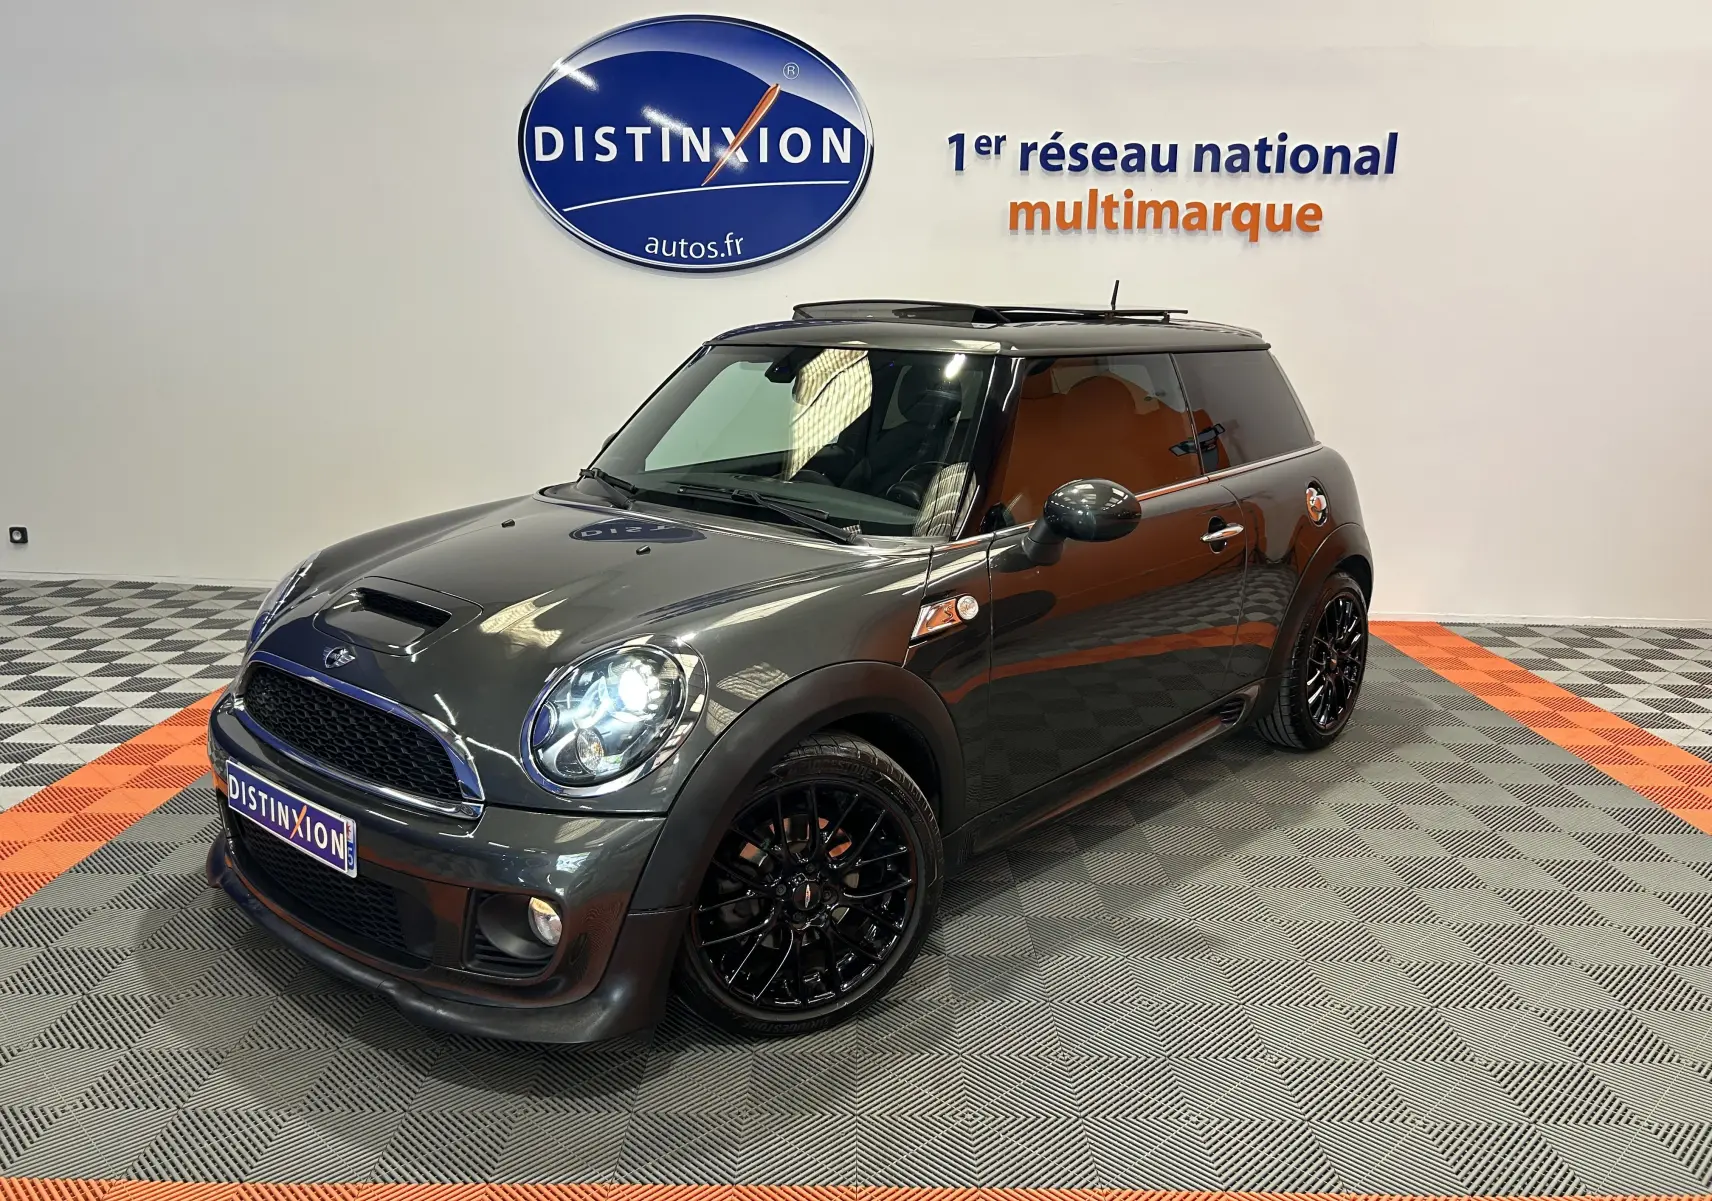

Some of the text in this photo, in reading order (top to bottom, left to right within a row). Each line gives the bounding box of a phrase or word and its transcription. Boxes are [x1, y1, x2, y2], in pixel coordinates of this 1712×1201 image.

[534, 126, 851, 164] DISTINXION
[1019, 131, 1178, 173] réseau
[1193, 132, 1399, 175] national
[1008, 188, 1323, 242] multimarque
[644, 232, 744, 260] autos.fr
[229, 773, 345, 860] DISTINXION
